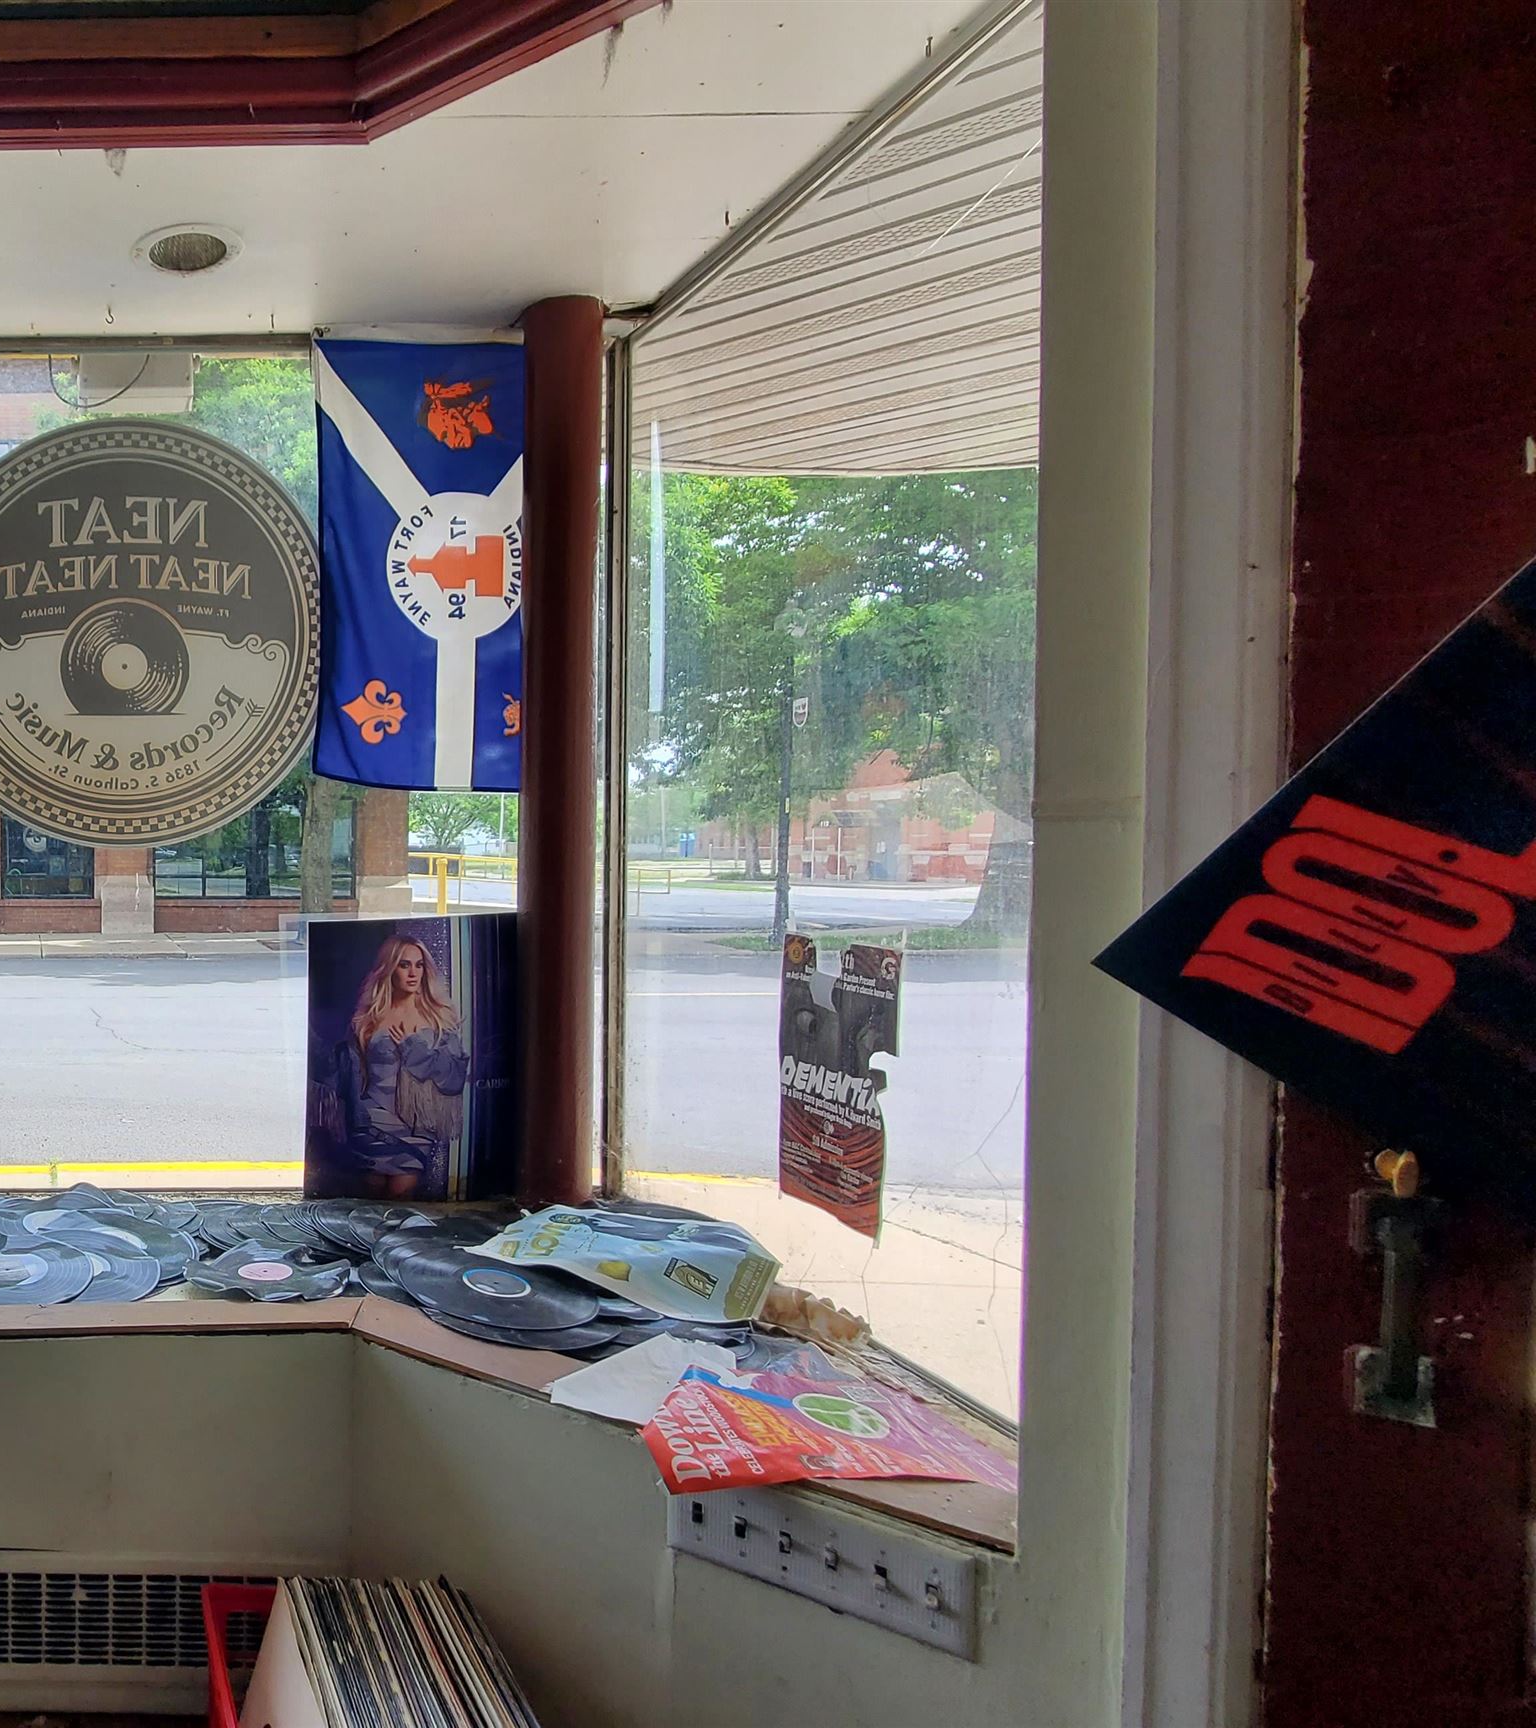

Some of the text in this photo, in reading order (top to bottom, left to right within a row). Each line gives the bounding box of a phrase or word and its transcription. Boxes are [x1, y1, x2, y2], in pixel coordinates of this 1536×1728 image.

[1180, 794, 1536, 1054] IDOL
[1263, 864, 1442, 1015] BILLY
[675, 1396, 730, 1452] Line
[722, 1429, 764, 1475] CELEBRATES
[706, 1453, 731, 1478] the
